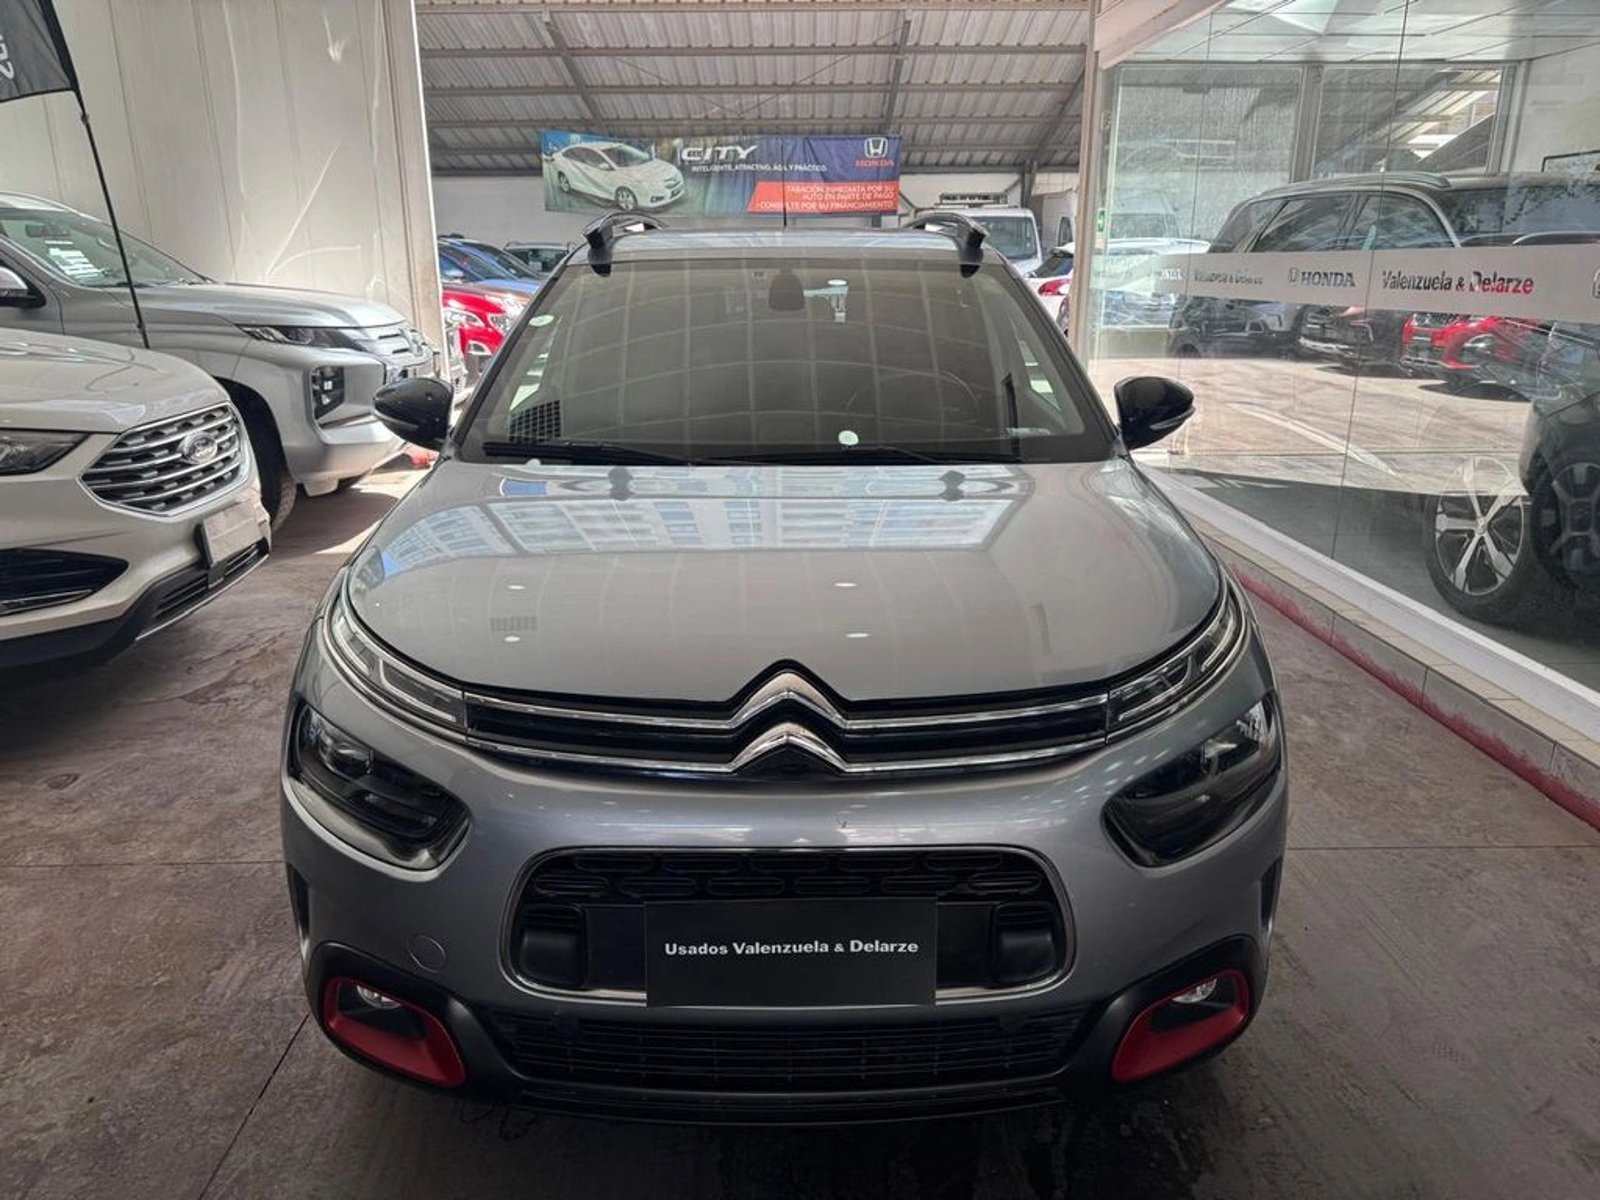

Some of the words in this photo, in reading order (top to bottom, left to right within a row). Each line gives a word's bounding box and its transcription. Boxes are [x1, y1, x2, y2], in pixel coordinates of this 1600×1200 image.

[681, 145, 759, 161] CITY
[855, 159, 895, 167] HONDA
[1301, 271, 1356, 288] HONDA
[1382, 270, 1453, 291] Valenzuela
[1455, 276, 1466, 292] &
[1470, 271, 1535, 294] Delarze
[664, 943, 728, 955] Usados
[732, 941, 829, 954] Valenzuela
[834, 944, 845, 953] &
[850, 939, 919, 953] Delarze
